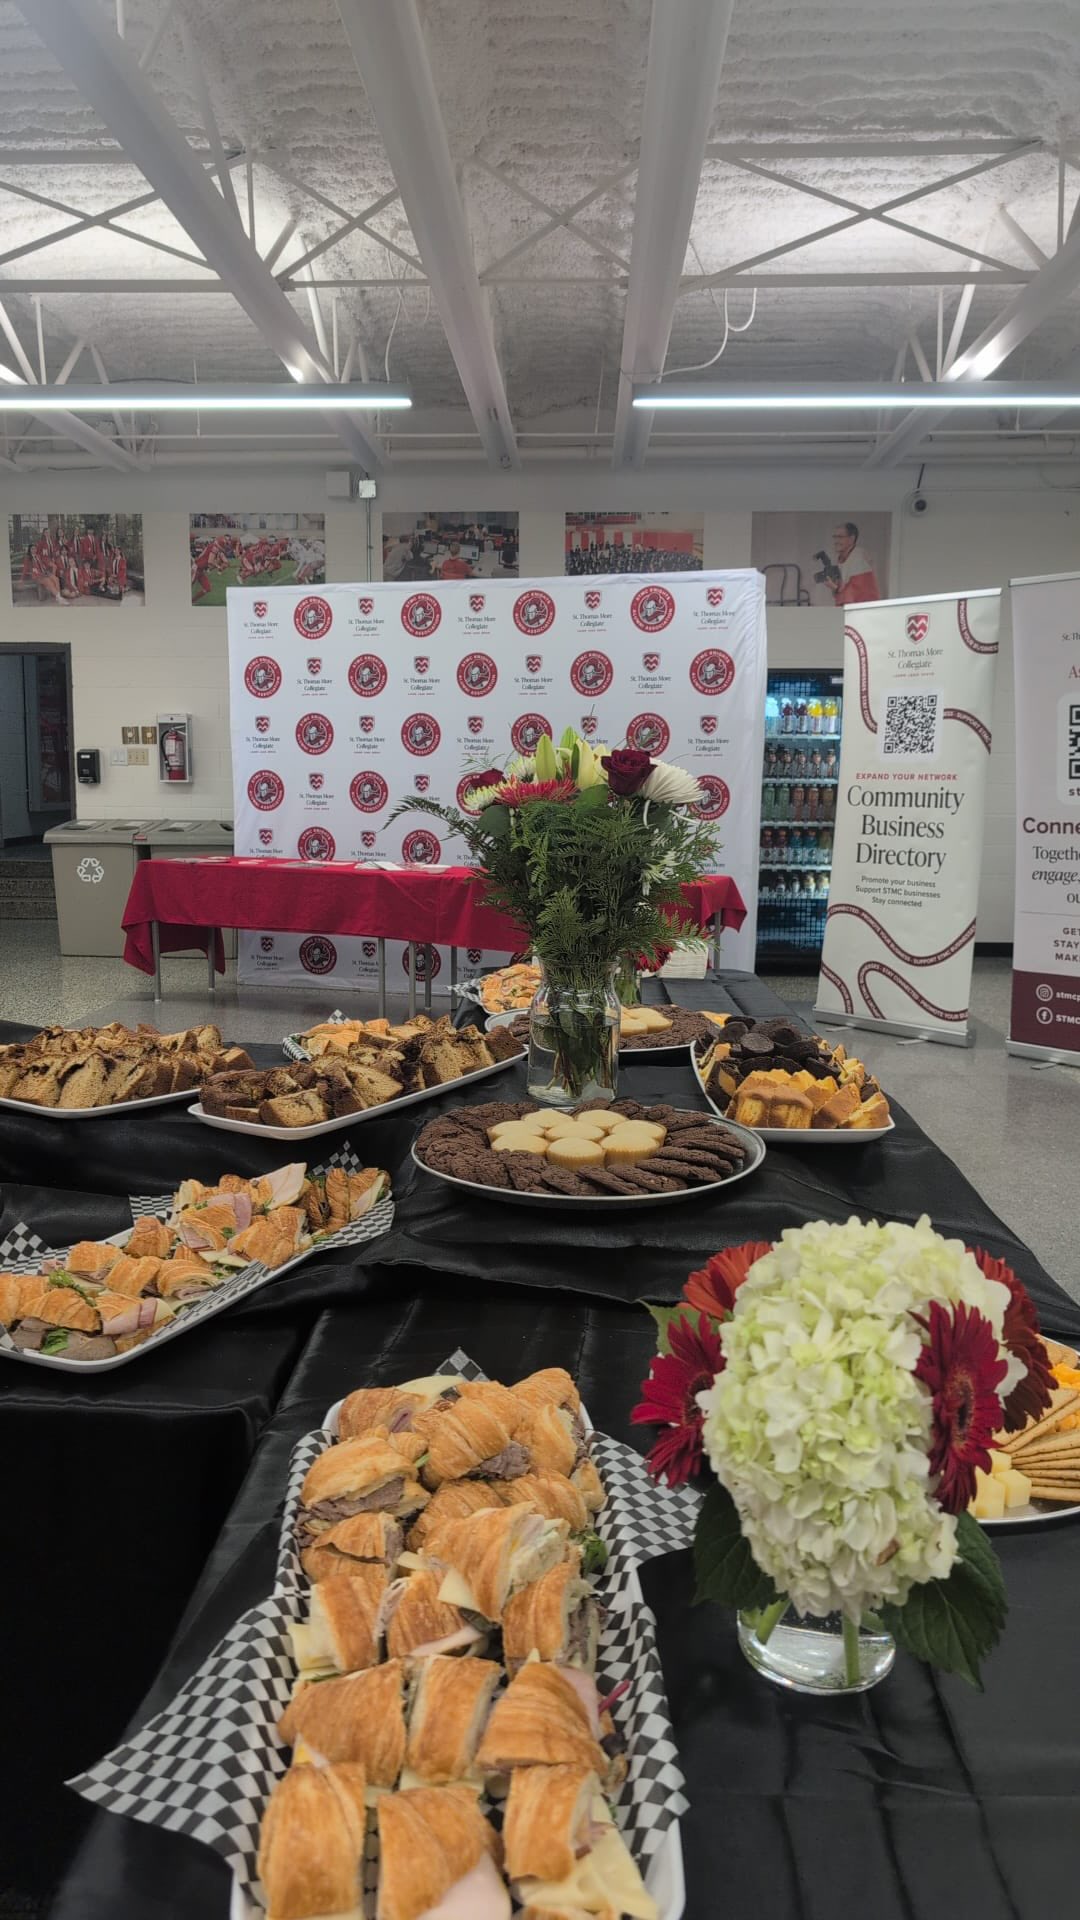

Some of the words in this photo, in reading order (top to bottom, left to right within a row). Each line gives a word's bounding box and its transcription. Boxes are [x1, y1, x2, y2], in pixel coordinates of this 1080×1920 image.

[898, 649, 924, 658] Thomas
[926, 648, 944, 656] More
[898, 660, 932, 670] Collegiate
[847, 785, 965, 815] Community
[861, 814, 944, 839] Business
[856, 842, 947, 874] Directory
[1032, 846, 1080, 864] Togeth
[861, 875, 889, 884] Promote
[907, 880, 936, 888] business
[856, 885, 881, 894] Support
[883, 887, 902, 895] STMC
[904, 890, 941, 898] businesses
[872, 896, 886, 906] Stay
[887, 898, 922, 907] connected
[1053, 940, 1079, 949] STAY
[1055, 952, 1080, 962] MAK
